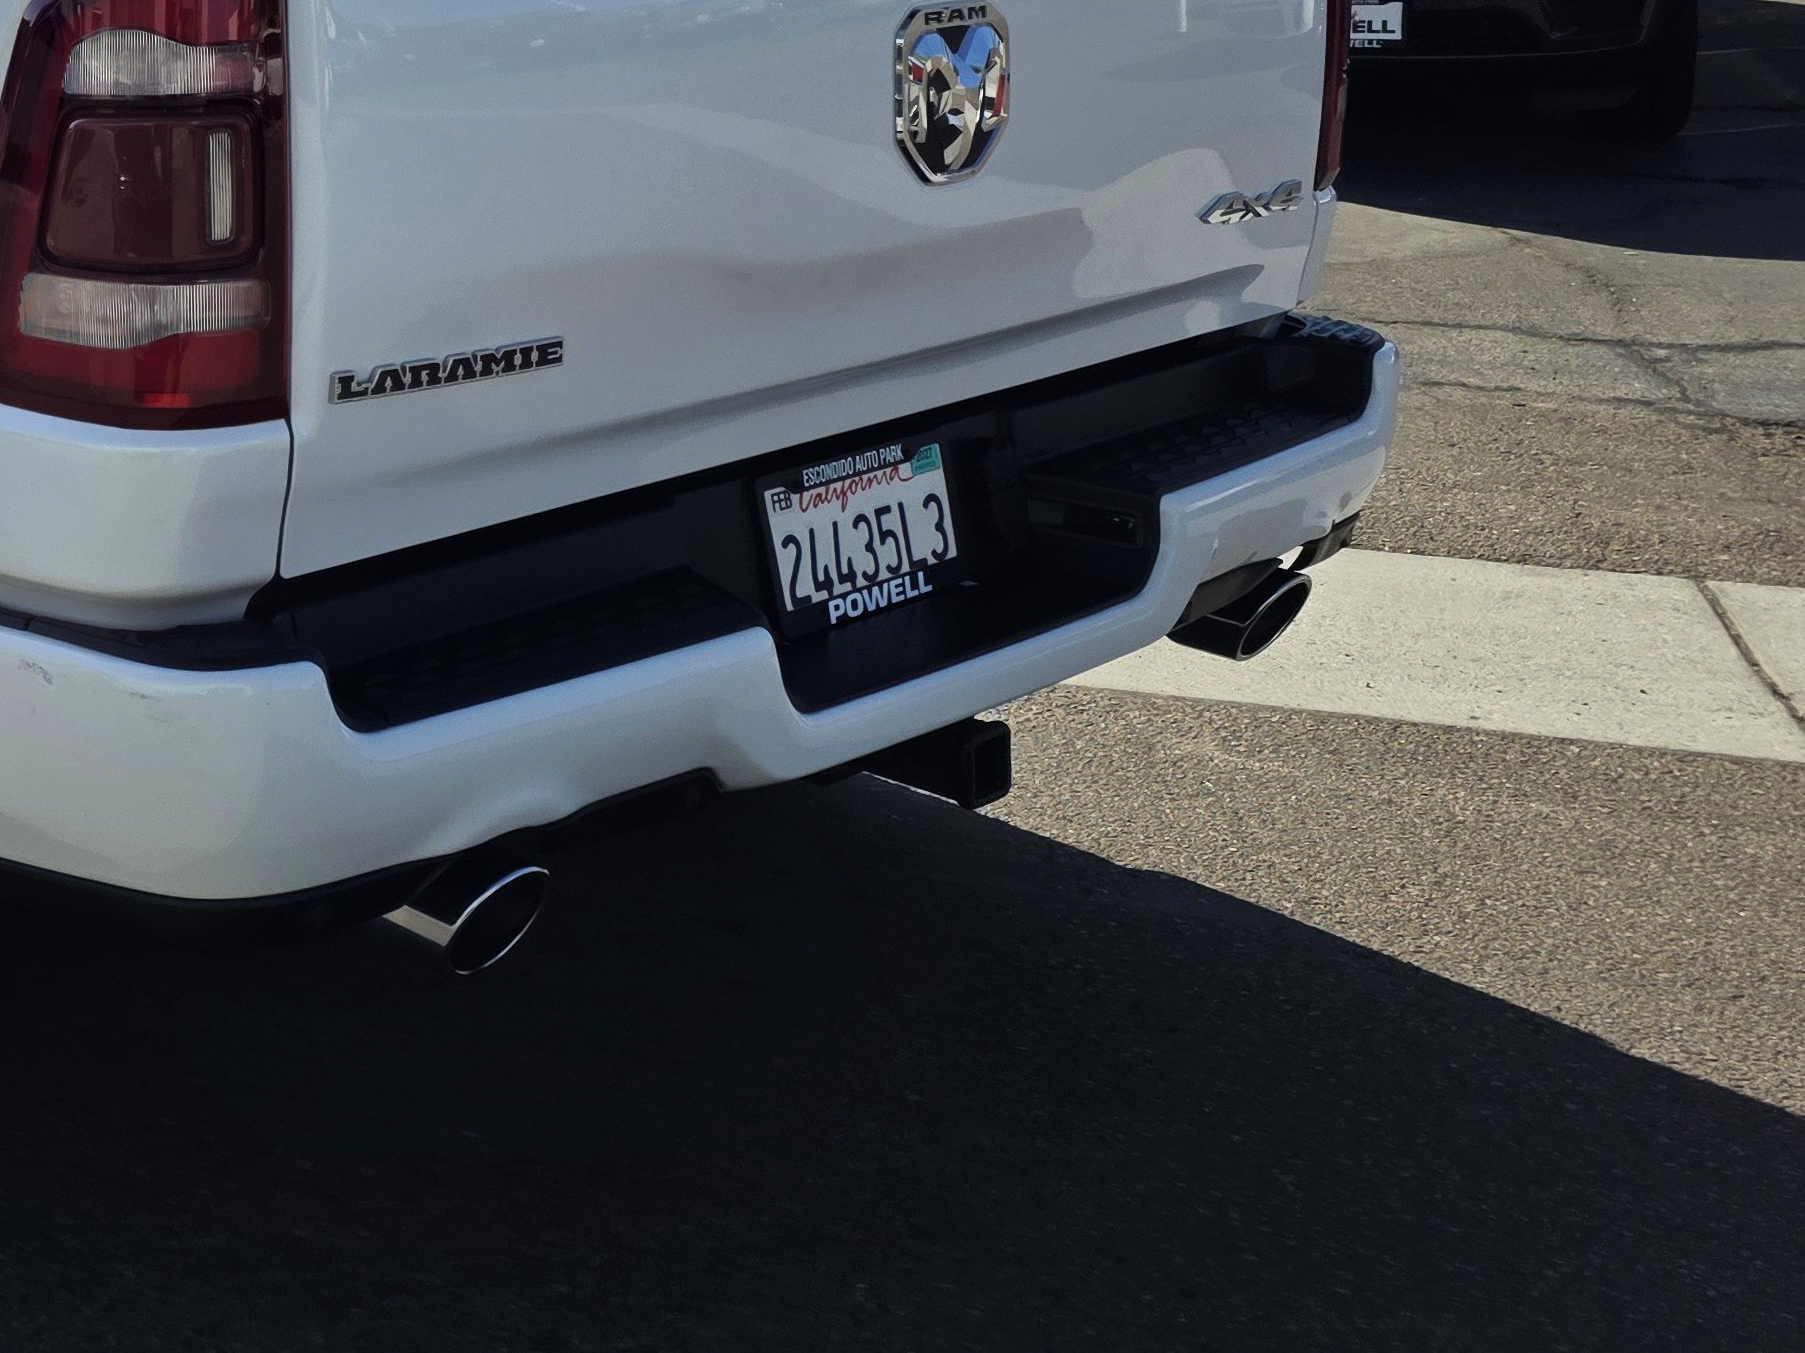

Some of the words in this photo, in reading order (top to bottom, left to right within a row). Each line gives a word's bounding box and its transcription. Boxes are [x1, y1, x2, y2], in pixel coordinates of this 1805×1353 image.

[924, 5, 988, 26] RAM
[328, 335, 564, 404] LARAMIE
[798, 464, 915, 514] California
[802, 457, 854, 487] ESCONDIDO
[855, 450, 879, 473] AUTO
[880, 443, 904, 467] PARK
[770, 490, 793, 514] FEB
[781, 493, 950, 611] 24435L3
[828, 571, 933, 625] POWELL
